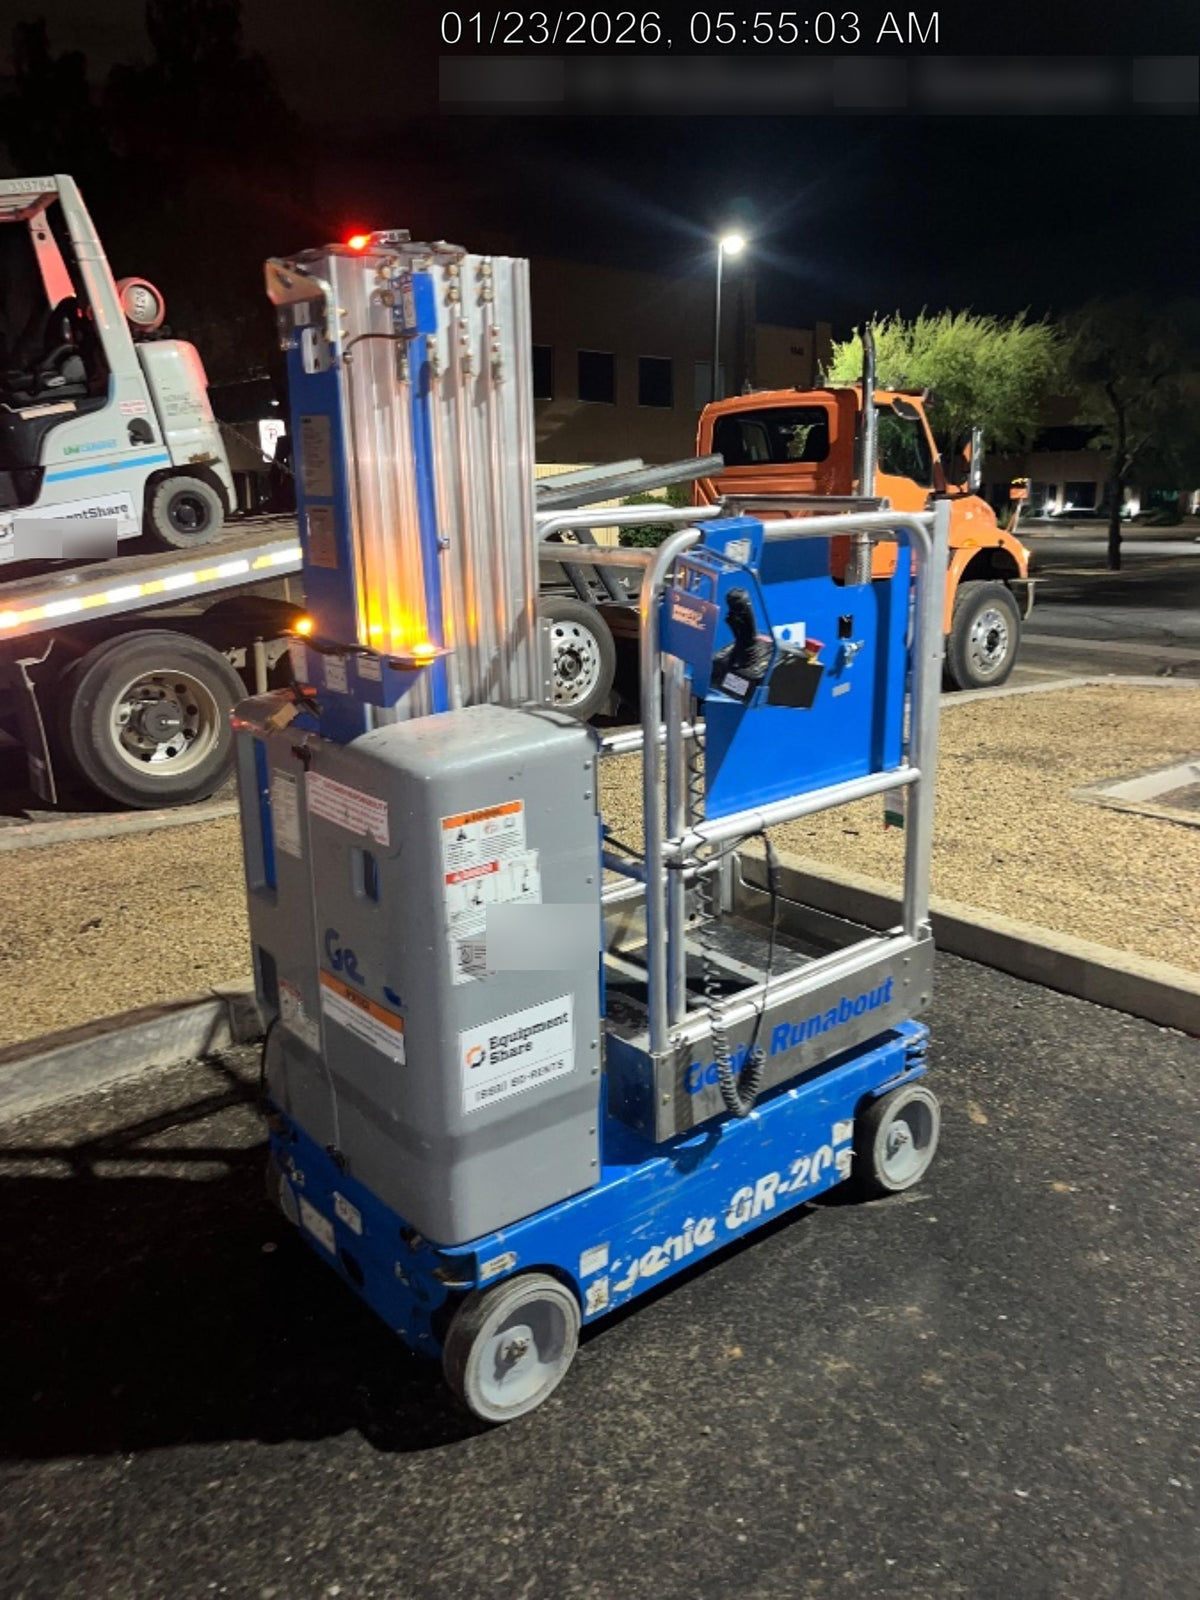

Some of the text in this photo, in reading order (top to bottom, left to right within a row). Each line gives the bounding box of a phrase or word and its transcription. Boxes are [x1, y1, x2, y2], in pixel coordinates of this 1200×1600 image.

[489, 1012, 569, 1050] Equipment
[770, 975, 894, 1056] Runabout
[489, 1041, 533, 1065] Share
